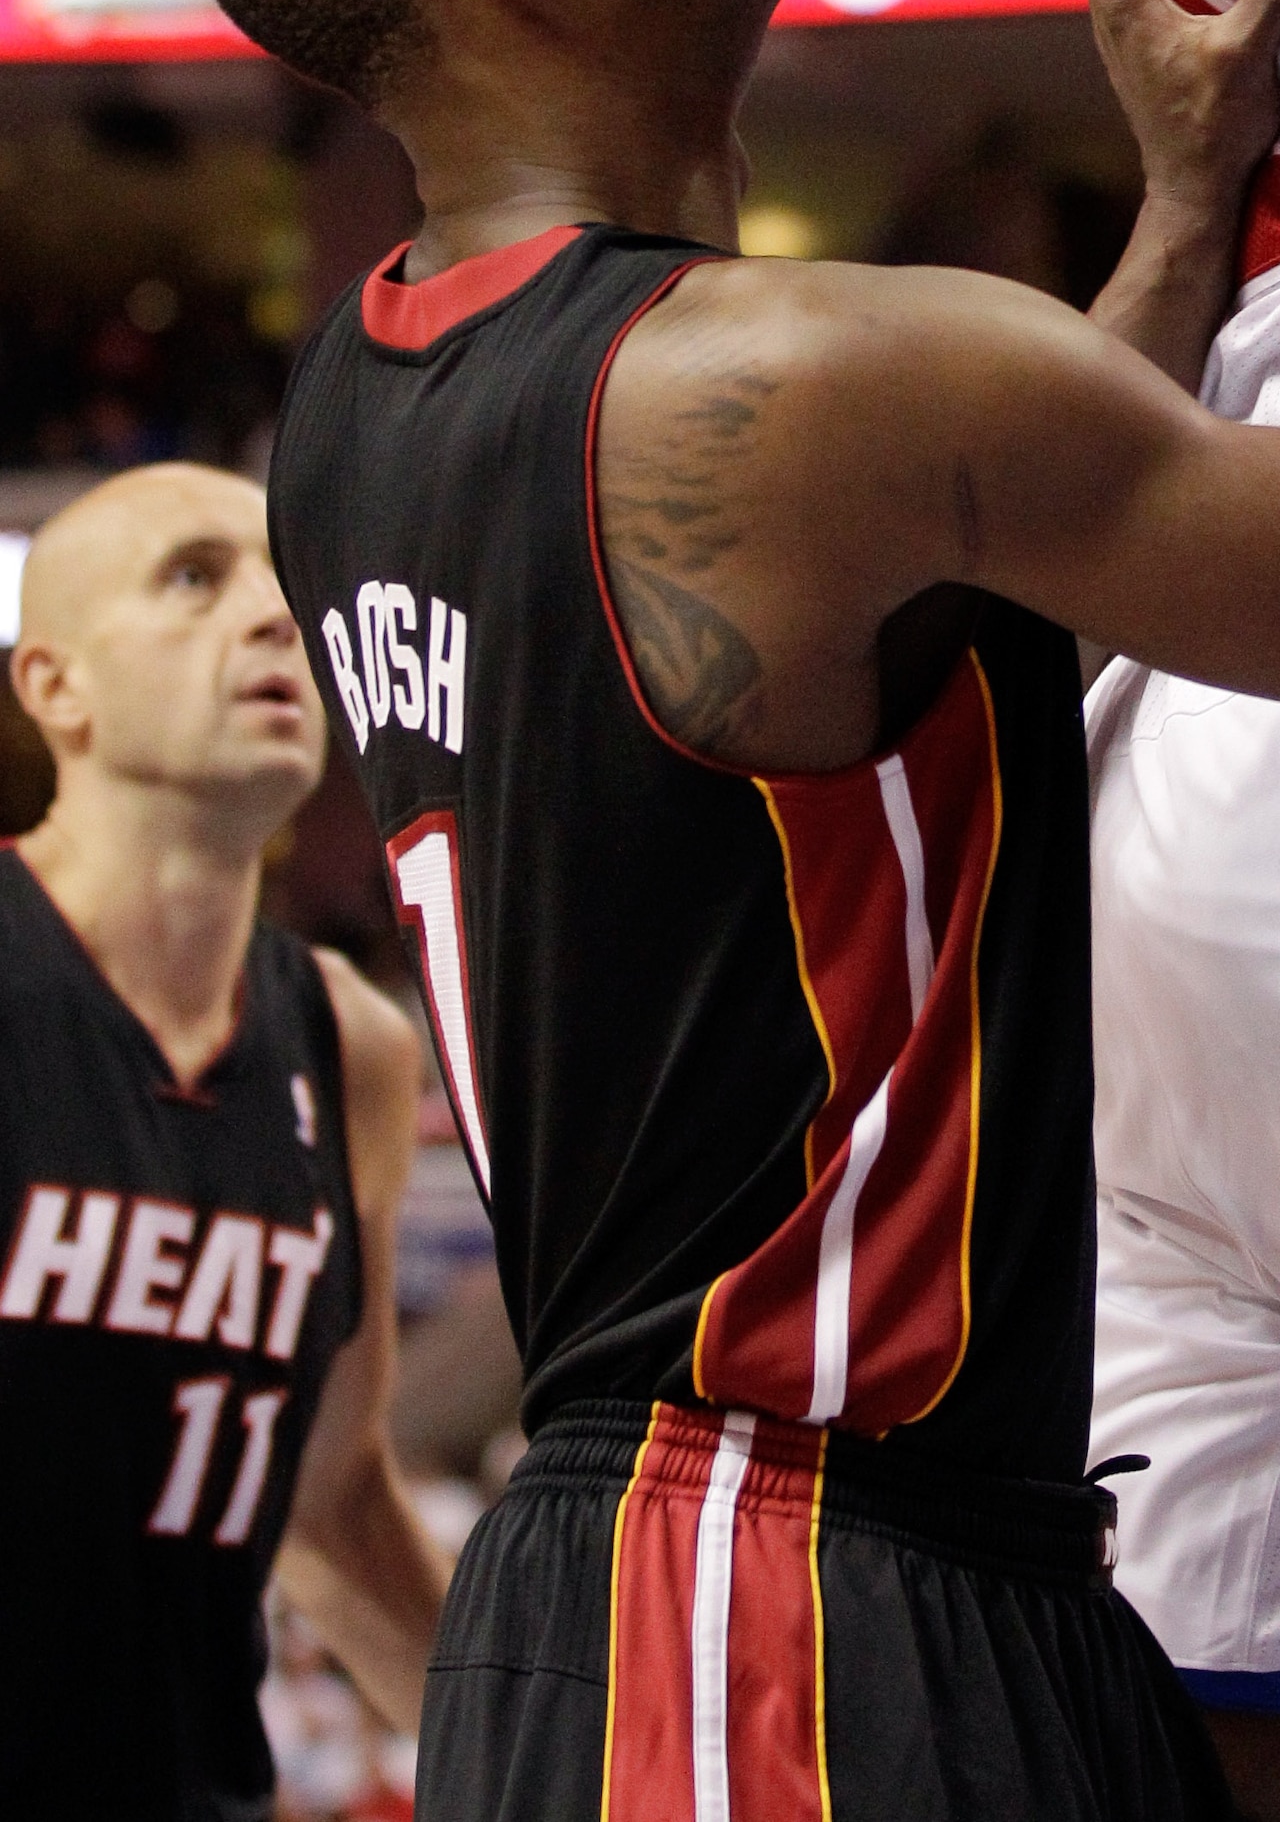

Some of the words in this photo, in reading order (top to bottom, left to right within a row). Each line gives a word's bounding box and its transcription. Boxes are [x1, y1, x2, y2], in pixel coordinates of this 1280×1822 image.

[321, 579, 467, 755] BOSH
[385, 809, 493, 1202] 1
[0, 1184, 335, 1360] HEAT
[147, 1375, 290, 1546] 11
